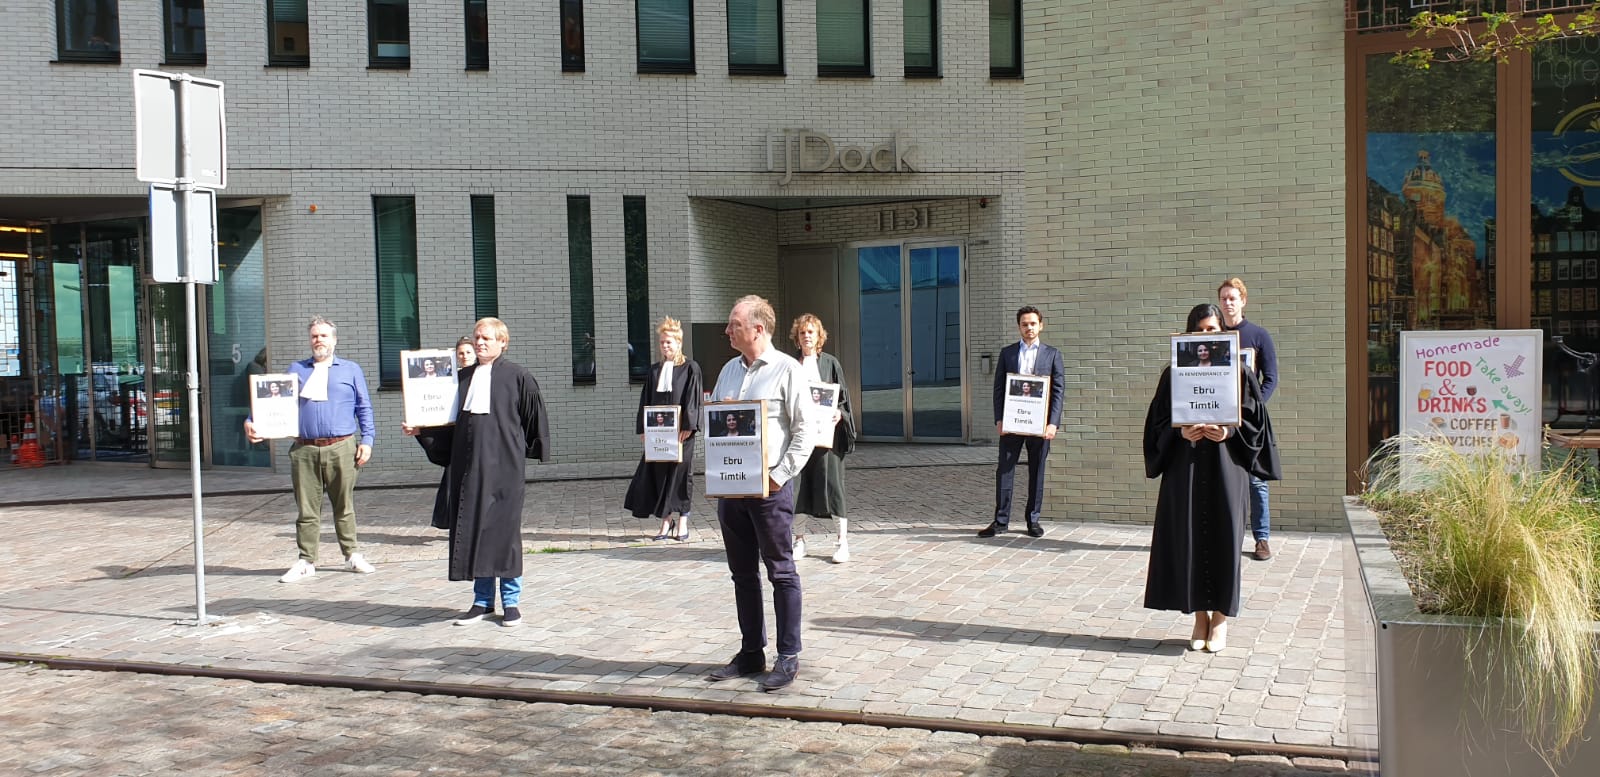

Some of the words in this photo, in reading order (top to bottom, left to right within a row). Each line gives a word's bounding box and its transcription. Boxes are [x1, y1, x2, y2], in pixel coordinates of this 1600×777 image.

[231, 343, 242, 364] 5
[1415, 335, 1501, 359] Homemade
[1424, 360, 1472, 377] FOOD
[1193, 386, 1216, 395] Ebru
[1438, 378, 1458, 396] &
[1474, 356, 1501, 384] Take
[1500, 384, 1534, 416] away!
[1189, 401, 1220, 410] Timtik
[1417, 396, 1487, 413] DRINKS
[723, 456, 743, 465] Ebru
[719, 471, 747, 481] Timtik
